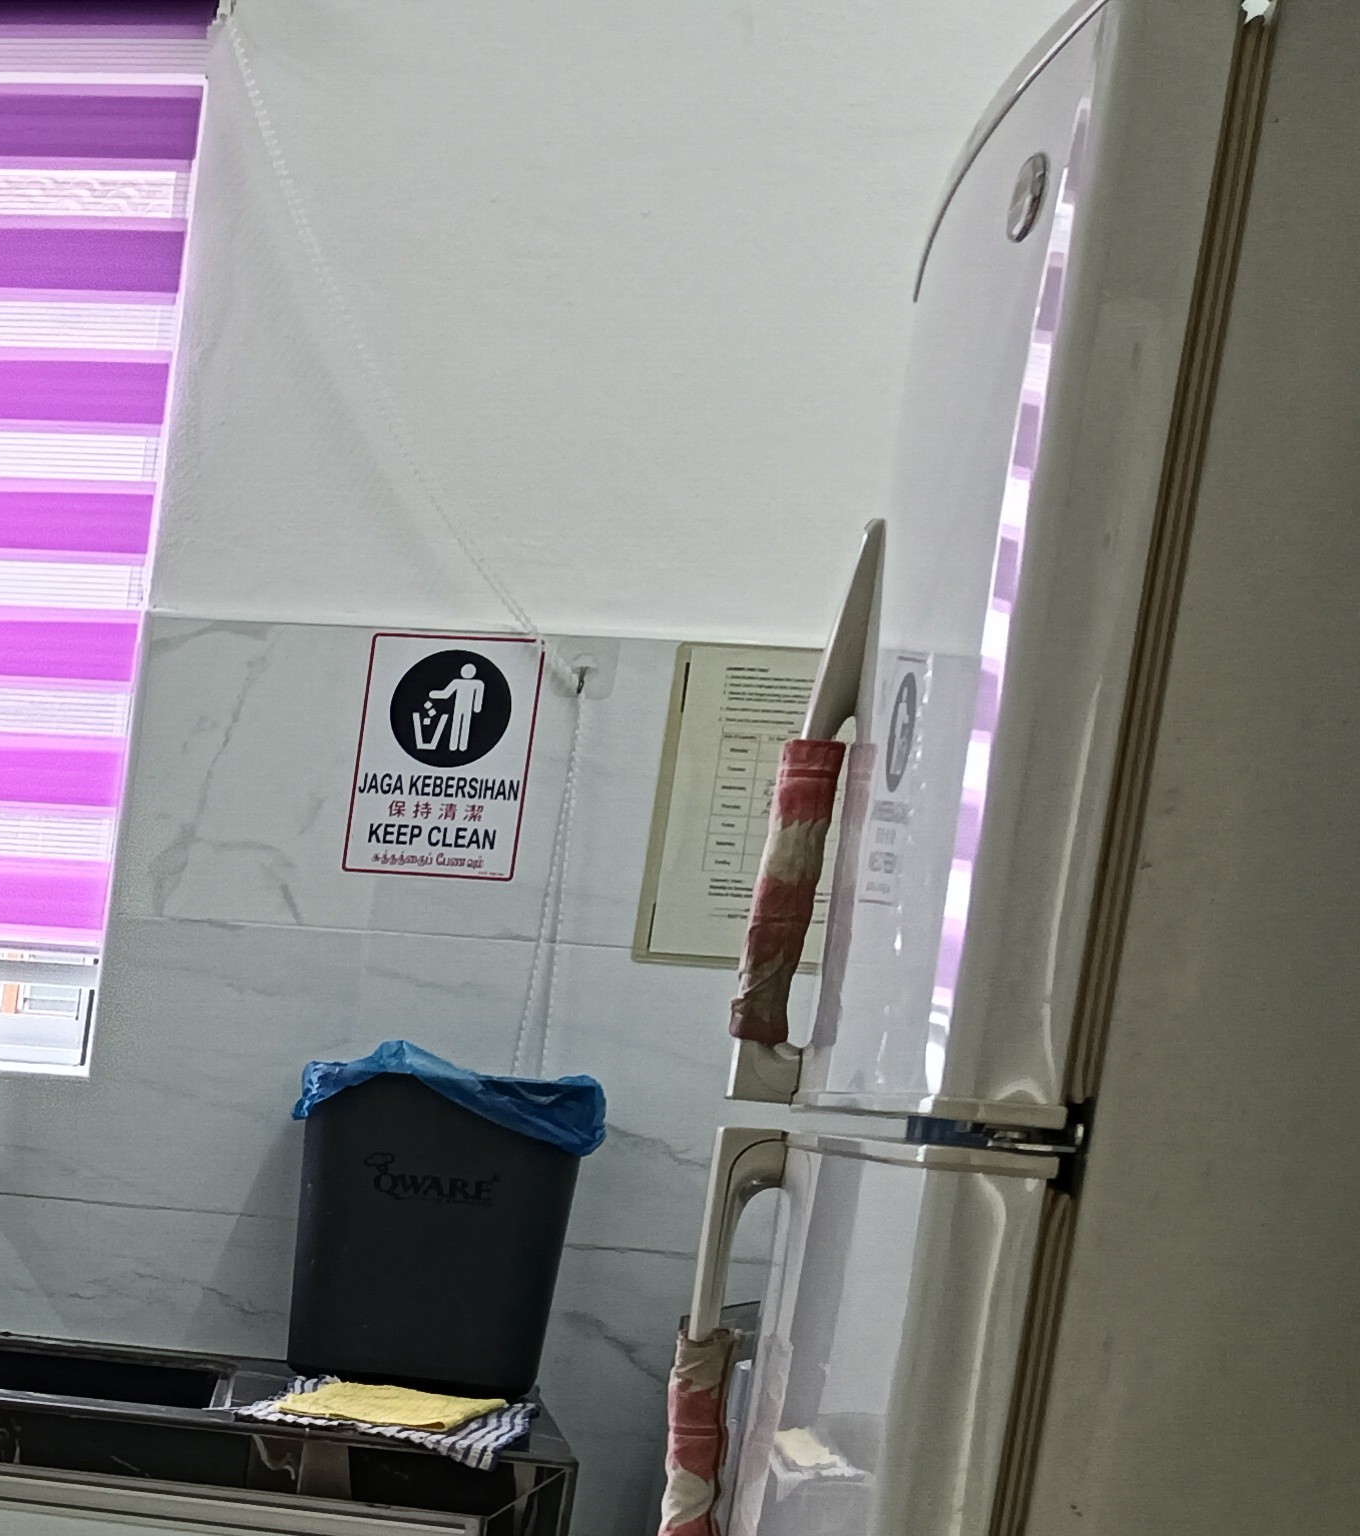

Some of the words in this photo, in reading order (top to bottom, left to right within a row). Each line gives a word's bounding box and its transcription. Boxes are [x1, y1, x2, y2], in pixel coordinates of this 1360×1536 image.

[358, 772, 404, 796] JAGA
[408, 774, 521, 802] KEBERSIHAN
[367, 822, 423, 846] KEEP
[427, 825, 497, 850] CLEAN
[373, 1172, 493, 1201] QWARE
